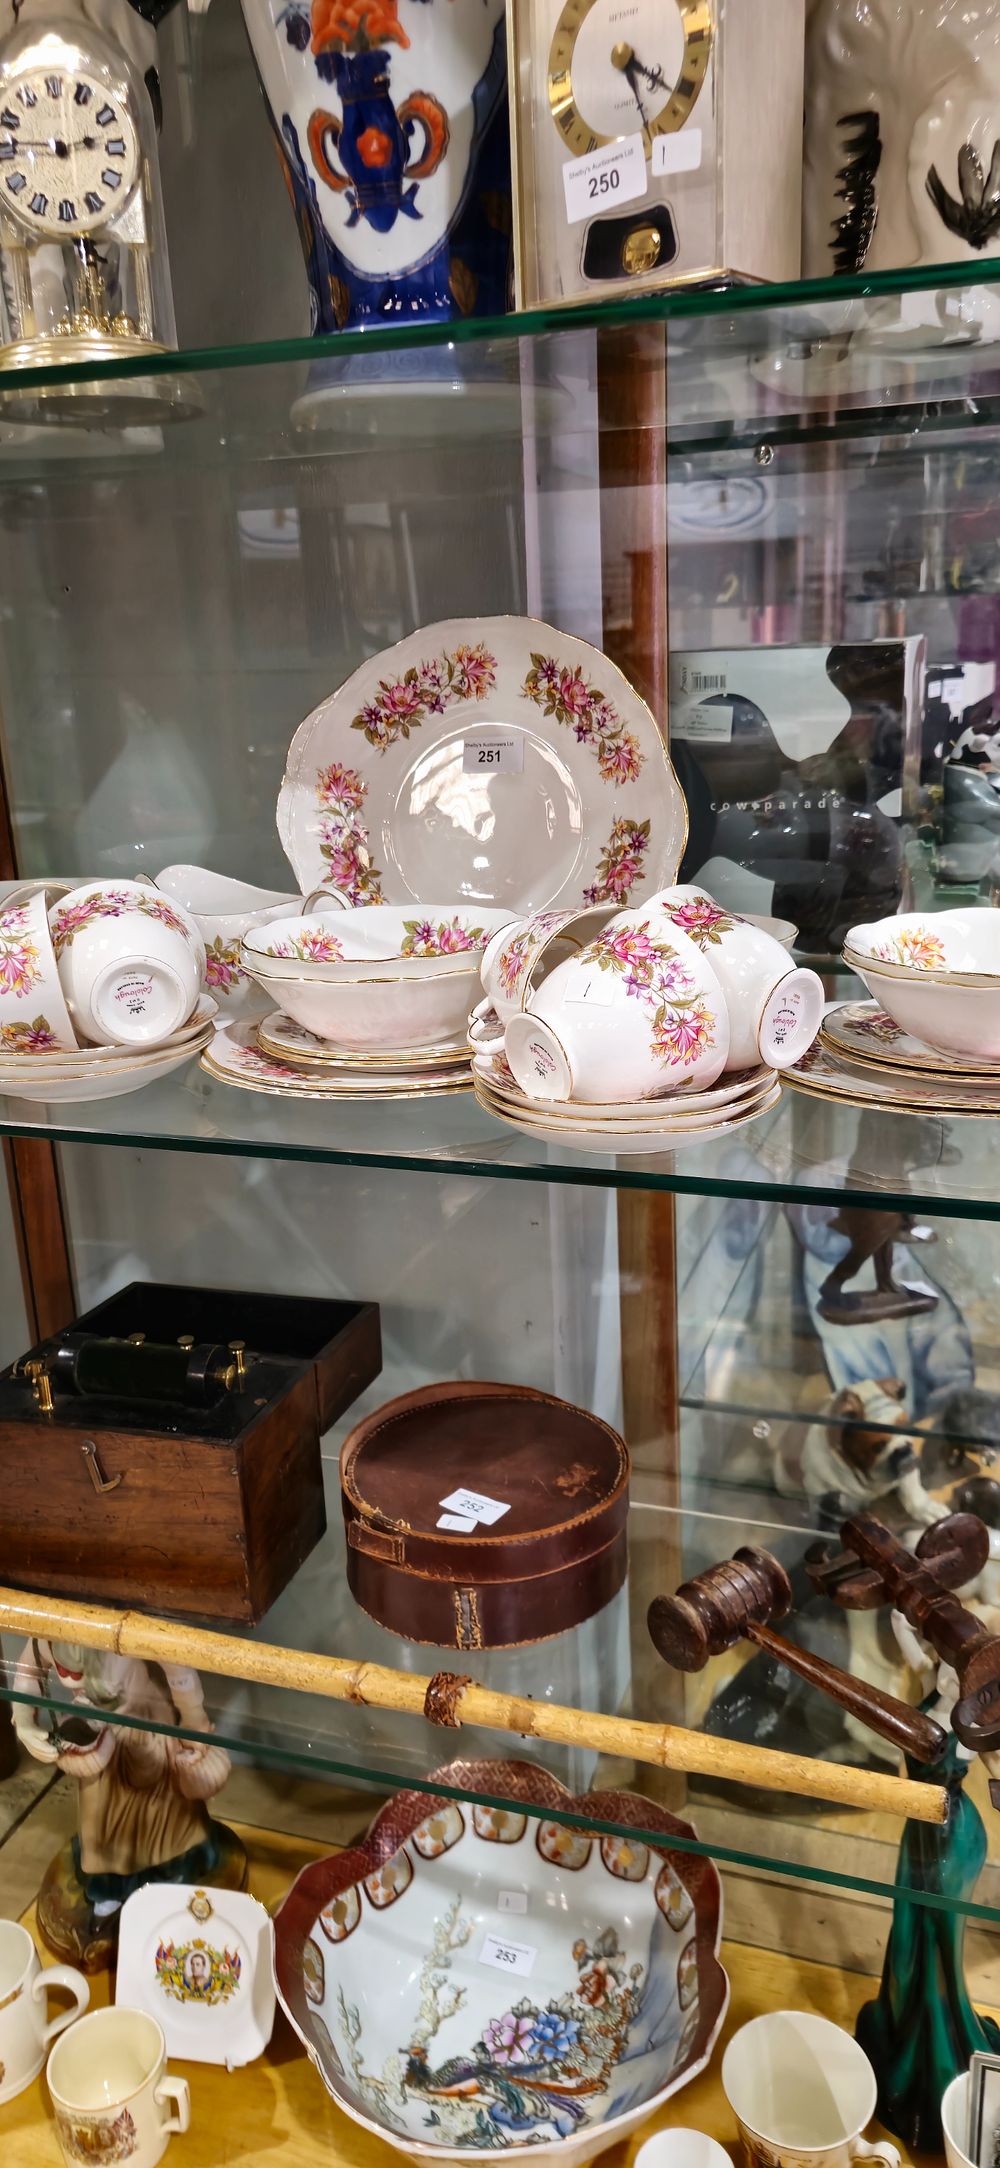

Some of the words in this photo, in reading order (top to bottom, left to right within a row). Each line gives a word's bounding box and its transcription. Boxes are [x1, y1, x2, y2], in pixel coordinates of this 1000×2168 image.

[624, 147, 635, 157] Ltd
[588, 169, 620, 199] 250
[478, 750, 501, 763] 251
[459, 1499, 485, 1513] 252
[495, 1948, 517, 1964] 253
